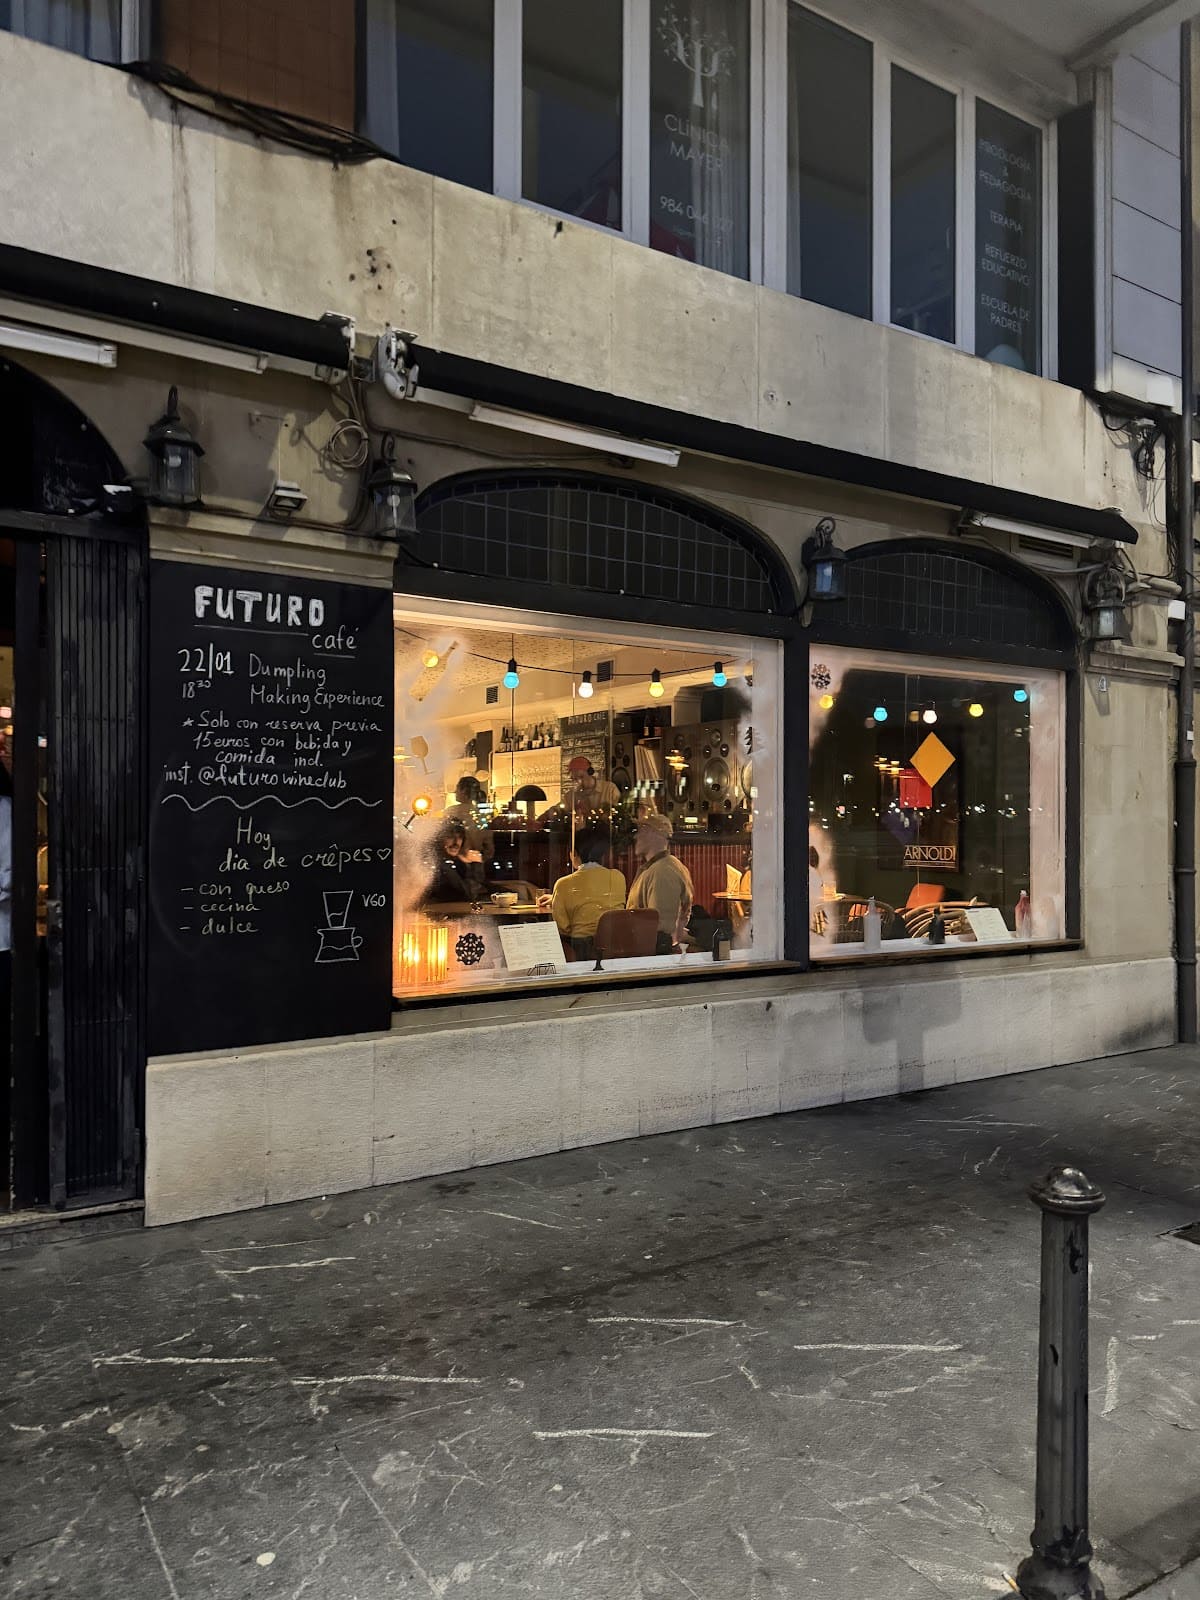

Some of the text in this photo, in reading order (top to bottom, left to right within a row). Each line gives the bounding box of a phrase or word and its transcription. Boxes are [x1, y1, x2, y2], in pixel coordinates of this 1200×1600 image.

[194, 585, 325, 627] FUTURO
[312, 625, 359, 650] café
[249, 653, 326, 686] Dumpling
[250, 684, 385, 713] Making Experience
[198, 710, 384, 736] Solo con reserva previa
[215, 747, 276, 765] comida
[261, 737, 285, 748] con
[295, 733, 339, 751] bebida
[343, 740, 352, 757] y
[236, 816, 271, 850] Hoy
[263, 847, 288, 870] de
[301, 843, 372, 873] crêpes
[199, 881, 290, 903] con queso
[200, 897, 261, 913] cecina
[201, 916, 259, 935] dulce
